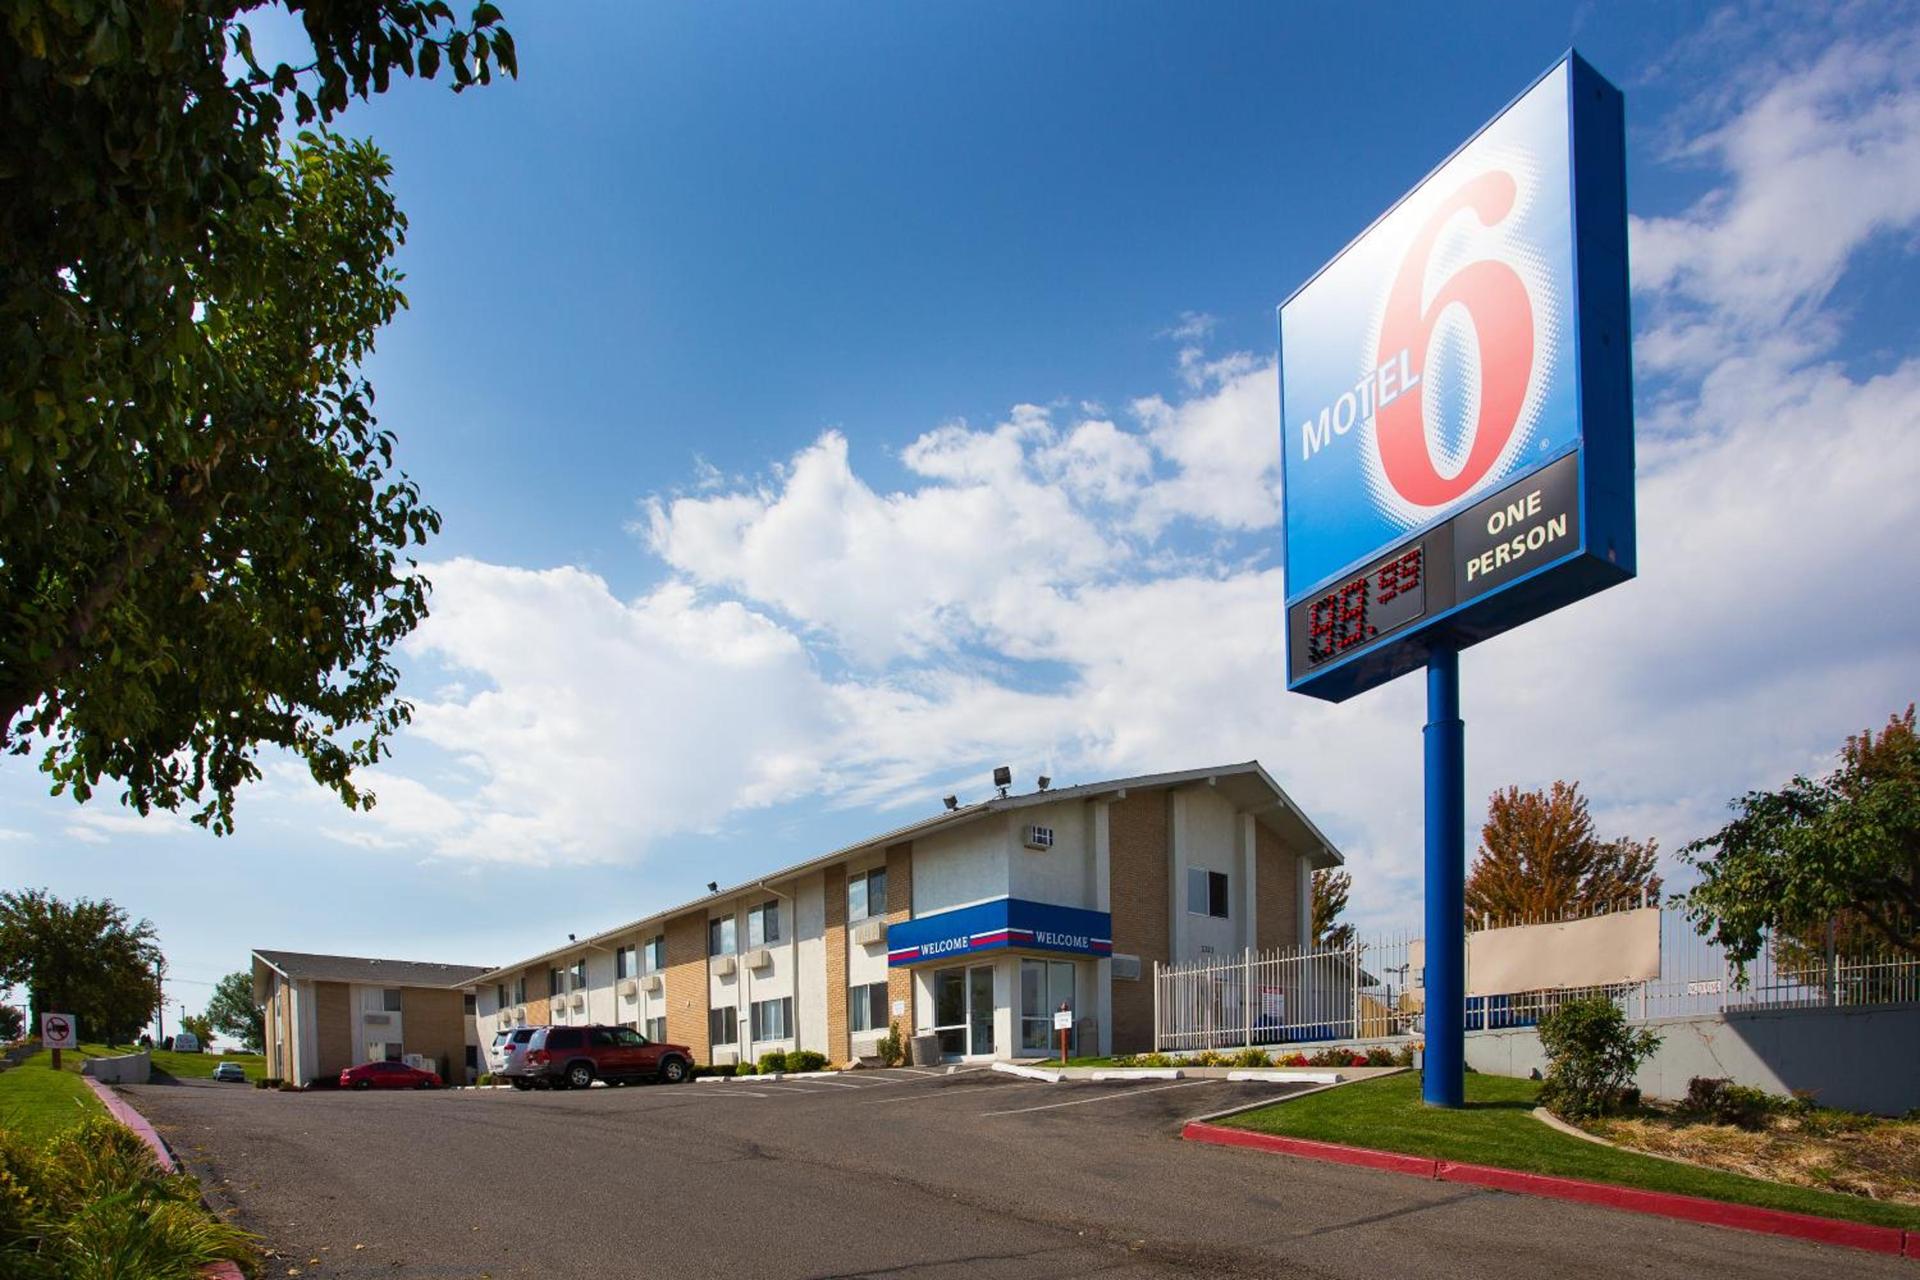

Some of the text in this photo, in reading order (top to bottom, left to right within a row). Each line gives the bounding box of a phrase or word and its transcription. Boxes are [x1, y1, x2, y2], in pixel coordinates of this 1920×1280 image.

[1302, 170, 1534, 507] MOTEL 6
[1486, 489, 1542, 535] ONE
[1466, 513, 1567, 582] PERSON
[920, 936, 970, 957] WELCOME
[1035, 930, 1089, 949] WELCOME
